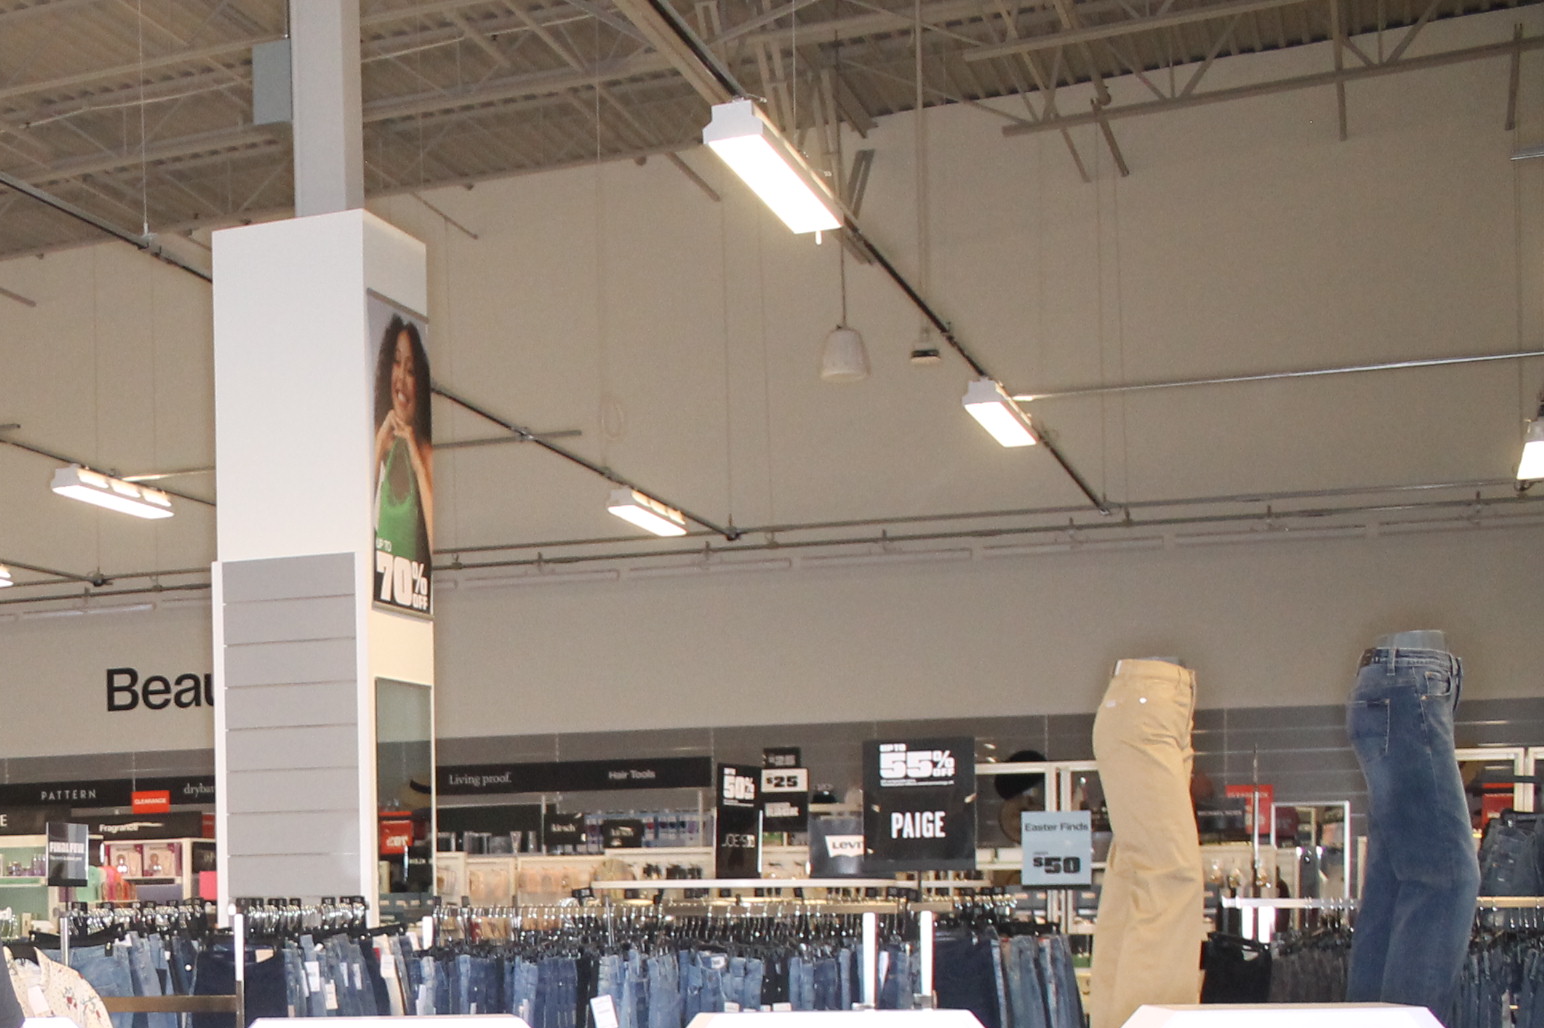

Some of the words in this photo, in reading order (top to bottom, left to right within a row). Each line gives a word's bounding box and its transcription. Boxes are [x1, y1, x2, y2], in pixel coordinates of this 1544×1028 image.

[376, 549, 428, 607] 70%
[413, 593, 428, 611] OFF
[880, 750, 955, 779] 55%
[448, 773, 481, 787] Living
[608, 770, 627, 780] Hair
[629, 769, 656, 779] Tools
[766, 776, 797, 788] $25
[40, 788, 97, 801] PATTERN
[891, 811, 946, 839] PAIGE
[1025, 823, 1056, 832] Easter
[1060, 822, 1089, 831] Finds
[1033, 857, 1081, 874] $50
